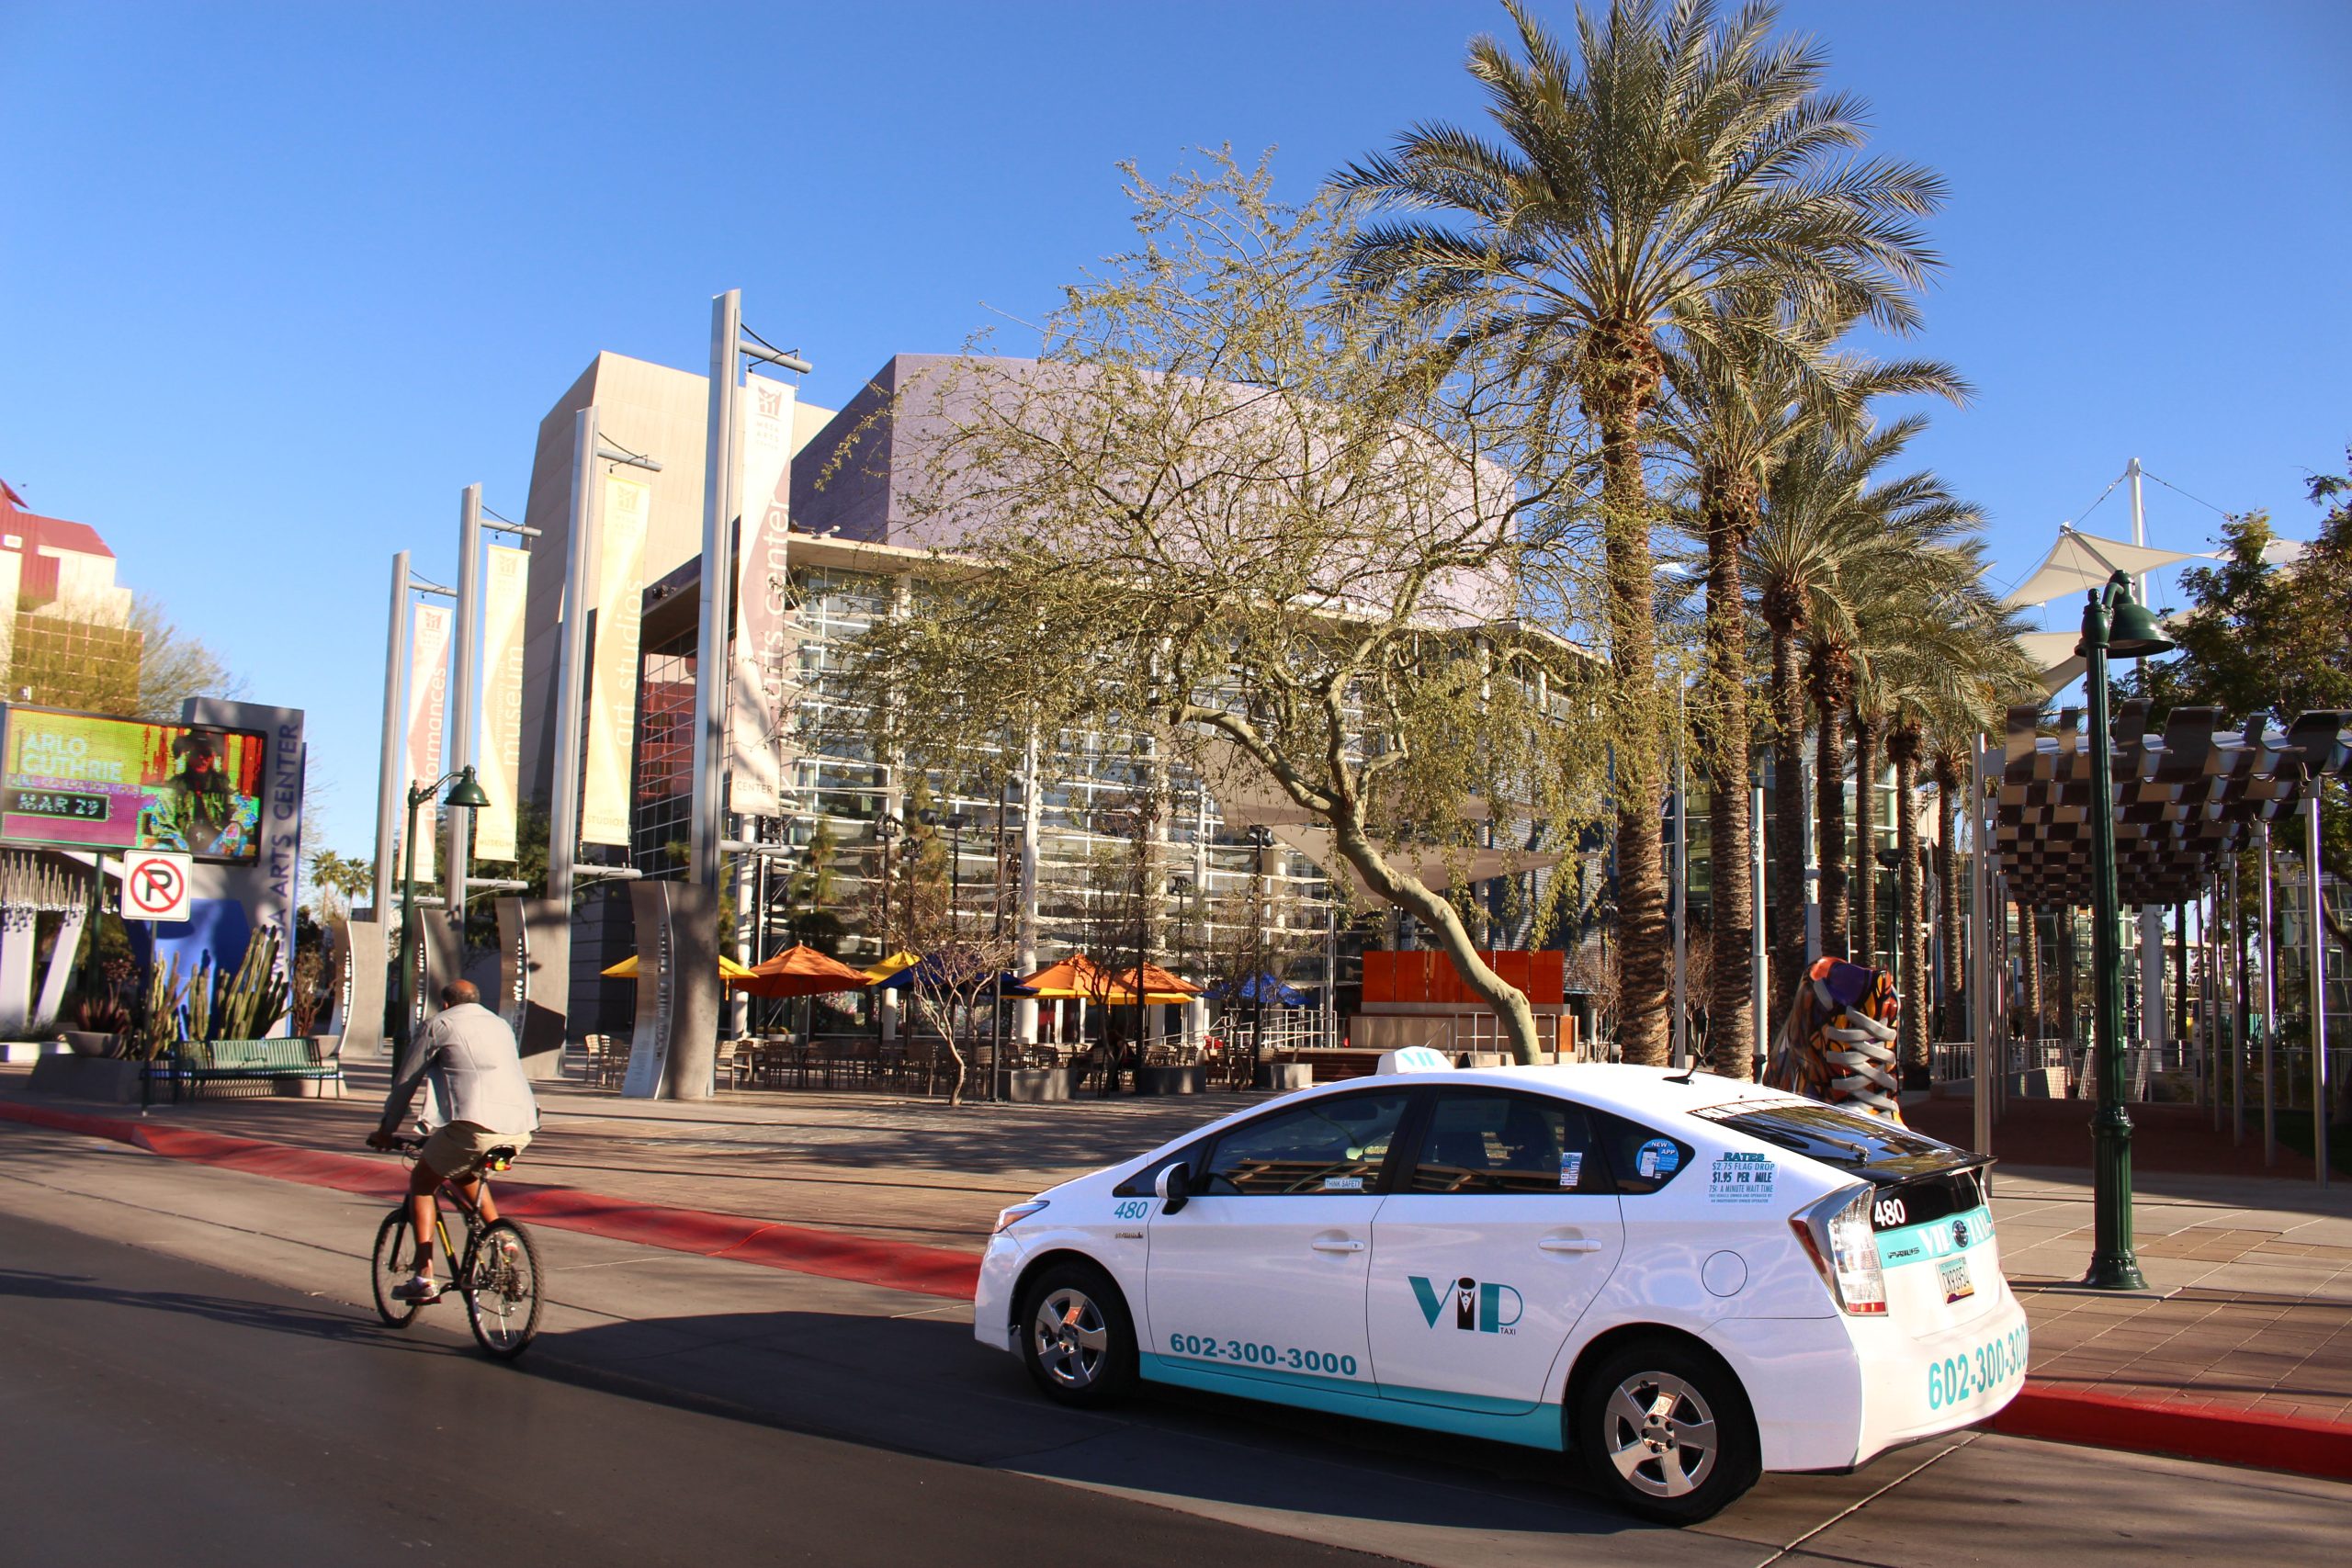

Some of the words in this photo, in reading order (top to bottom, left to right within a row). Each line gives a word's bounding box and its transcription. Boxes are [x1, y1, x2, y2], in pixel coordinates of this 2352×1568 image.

[763, 491, 789, 615] center
[615, 579, 643, 691] studios
[760, 631, 784, 700] arts
[503, 646, 524, 766] museum
[613, 700, 634, 748] art
[22, 732, 87, 757] ARLO
[418, 666, 447, 821] peformances
[21, 753, 123, 782] GUTHRIE
[274, 724, 300, 820] CENTER
[736, 780, 774, 795] CENTER
[18, 793, 68, 813] MAR
[586, 815, 626, 828] STUDIOS
[270, 835, 291, 897] ARTS
[1712, 1162, 1733, 1170] $2.75
[1755, 1163, 1775, 1171] DROP
[1723, 1151, 1765, 1161] RATES
[1327, 1179, 1340, 1188] THINK
[1341, 1179, 1361, 1188] SAFETY
[1712, 1171, 1733, 1184] $1.95
[1736, 1171, 1750, 1183] PER
[1754, 1171, 1772, 1183] MILE
[1114, 1201, 1148, 1219] 480
[1874, 1198, 1906, 1227] 480
[1887, 1247, 1920, 1258] PRIUS
[1499, 1326, 1516, 1336] TAXI
[1170, 1333, 1357, 1376] 602-300-3000
